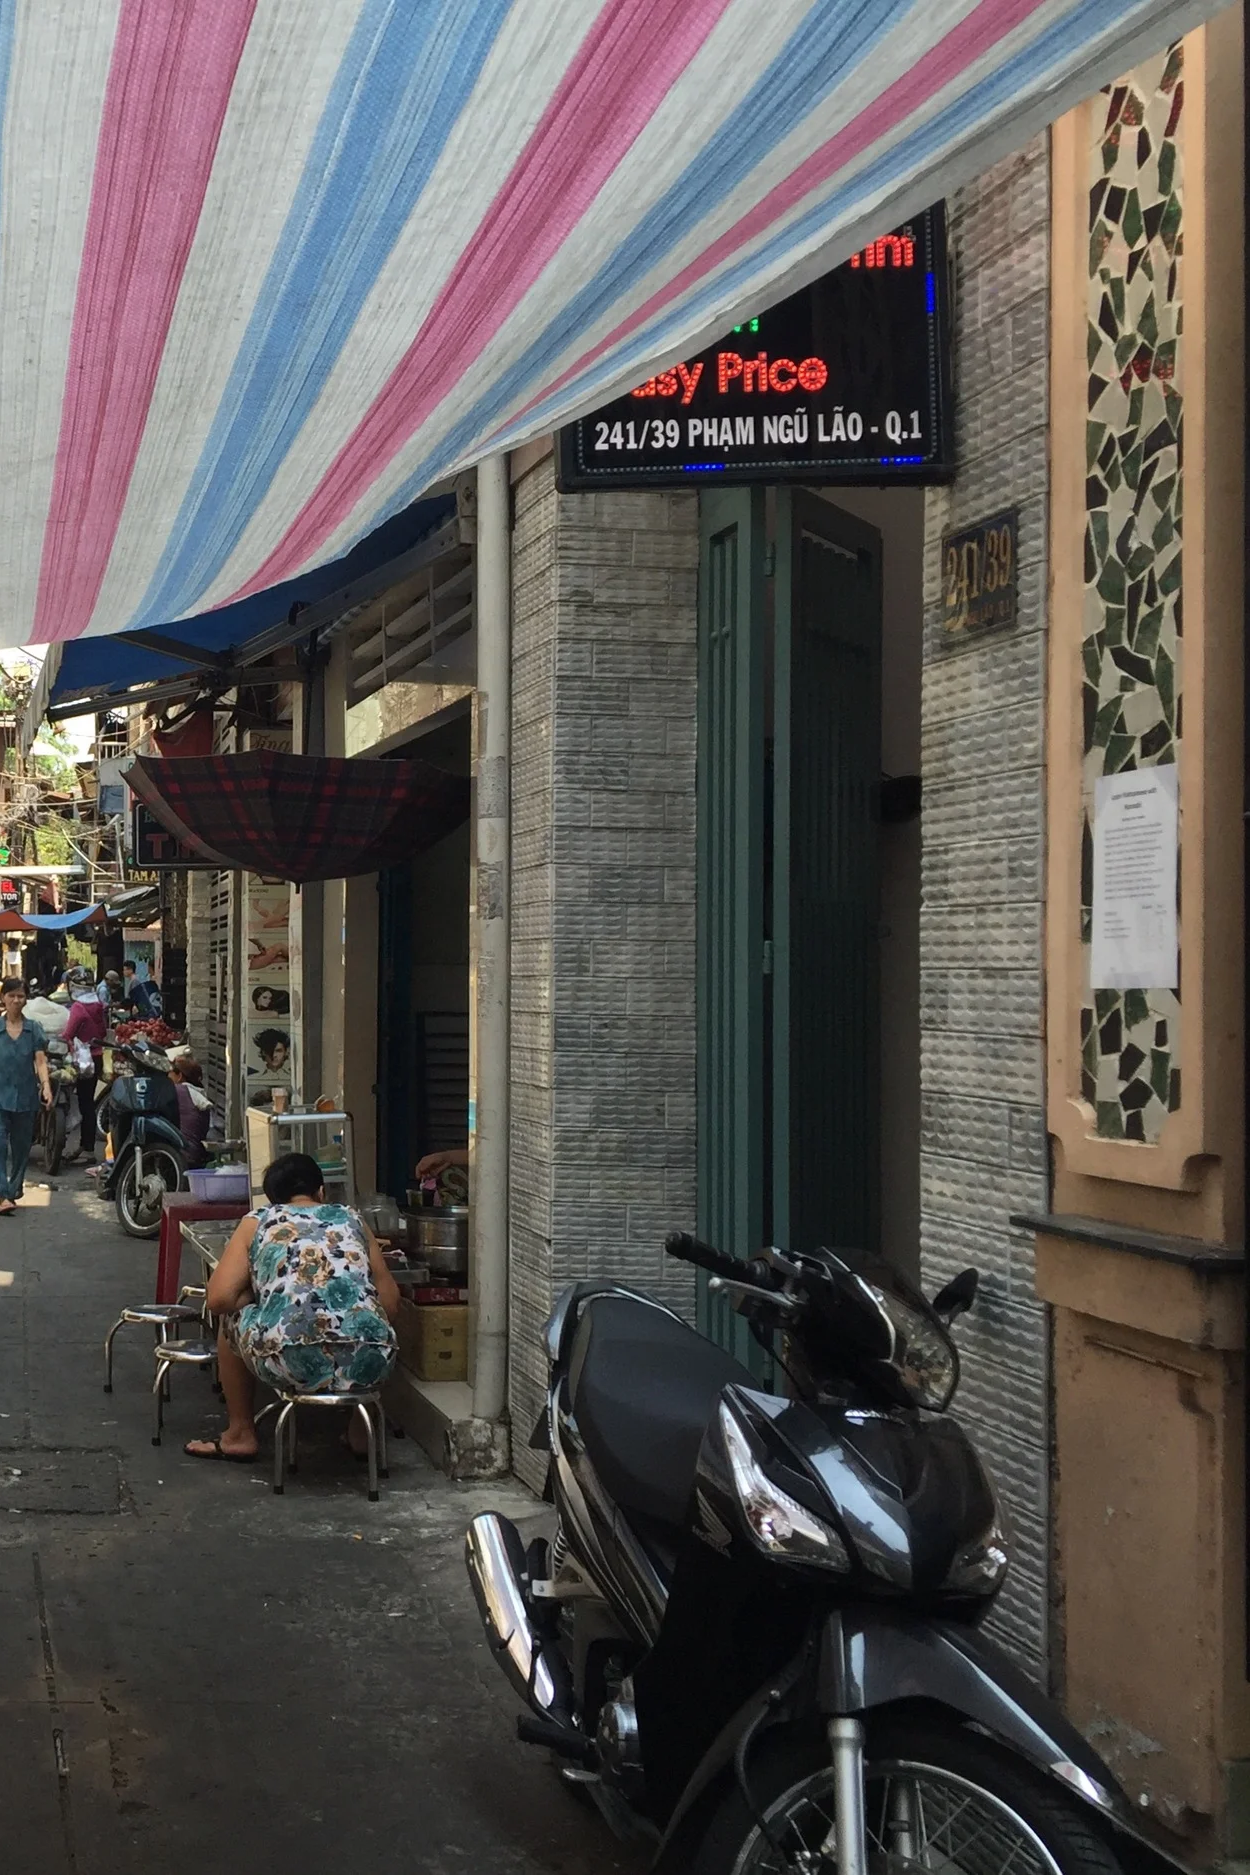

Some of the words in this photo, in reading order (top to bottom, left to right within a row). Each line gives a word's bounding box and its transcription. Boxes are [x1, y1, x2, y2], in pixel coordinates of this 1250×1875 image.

[718, 352, 828, 393] Price
[595, 418, 680, 450] 241/39
[688, 416, 755, 452] PHẠM
[763, 407, 809, 445] NGŨ
[817, 405, 863, 442] LÃO
[886, 410, 922, 443] Q.1
